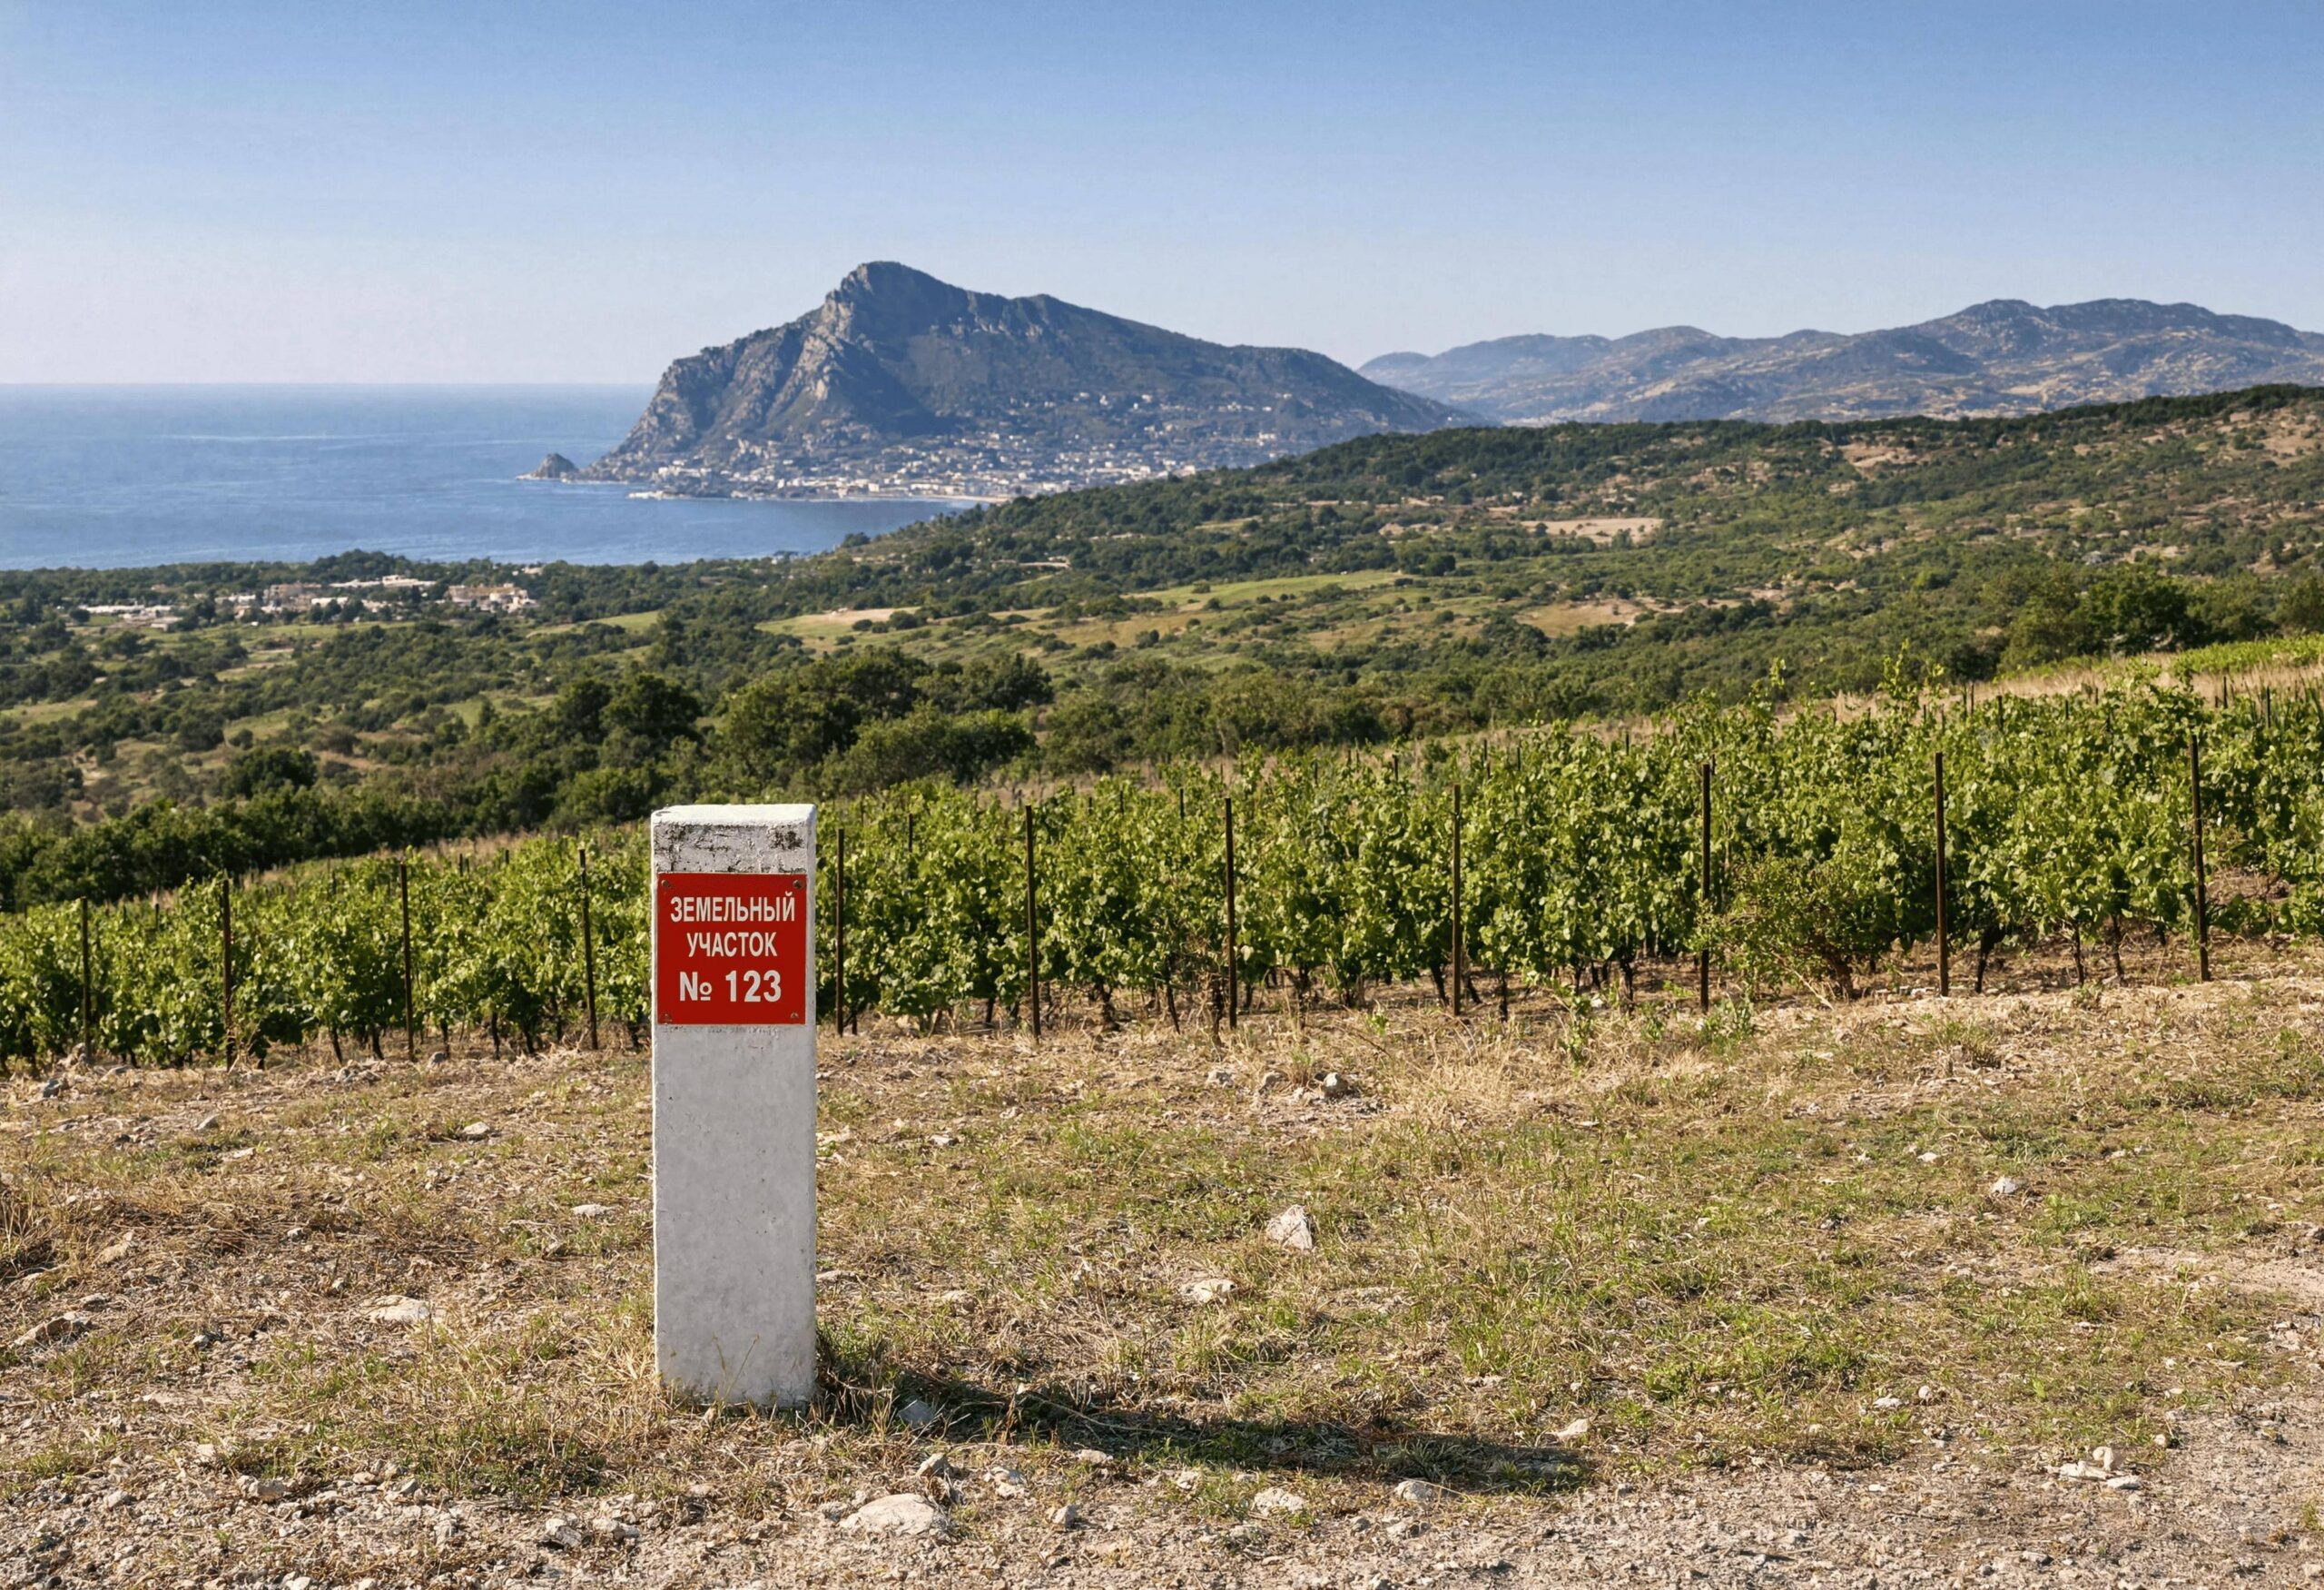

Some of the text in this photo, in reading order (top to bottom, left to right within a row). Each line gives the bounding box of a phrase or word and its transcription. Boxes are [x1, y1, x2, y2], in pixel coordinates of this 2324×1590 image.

[670, 891, 795, 923] ЗЕМЕЛЬНЫЙ
[686, 932, 778, 957] УЧАСТОК
[679, 969, 782, 1002] № 123
